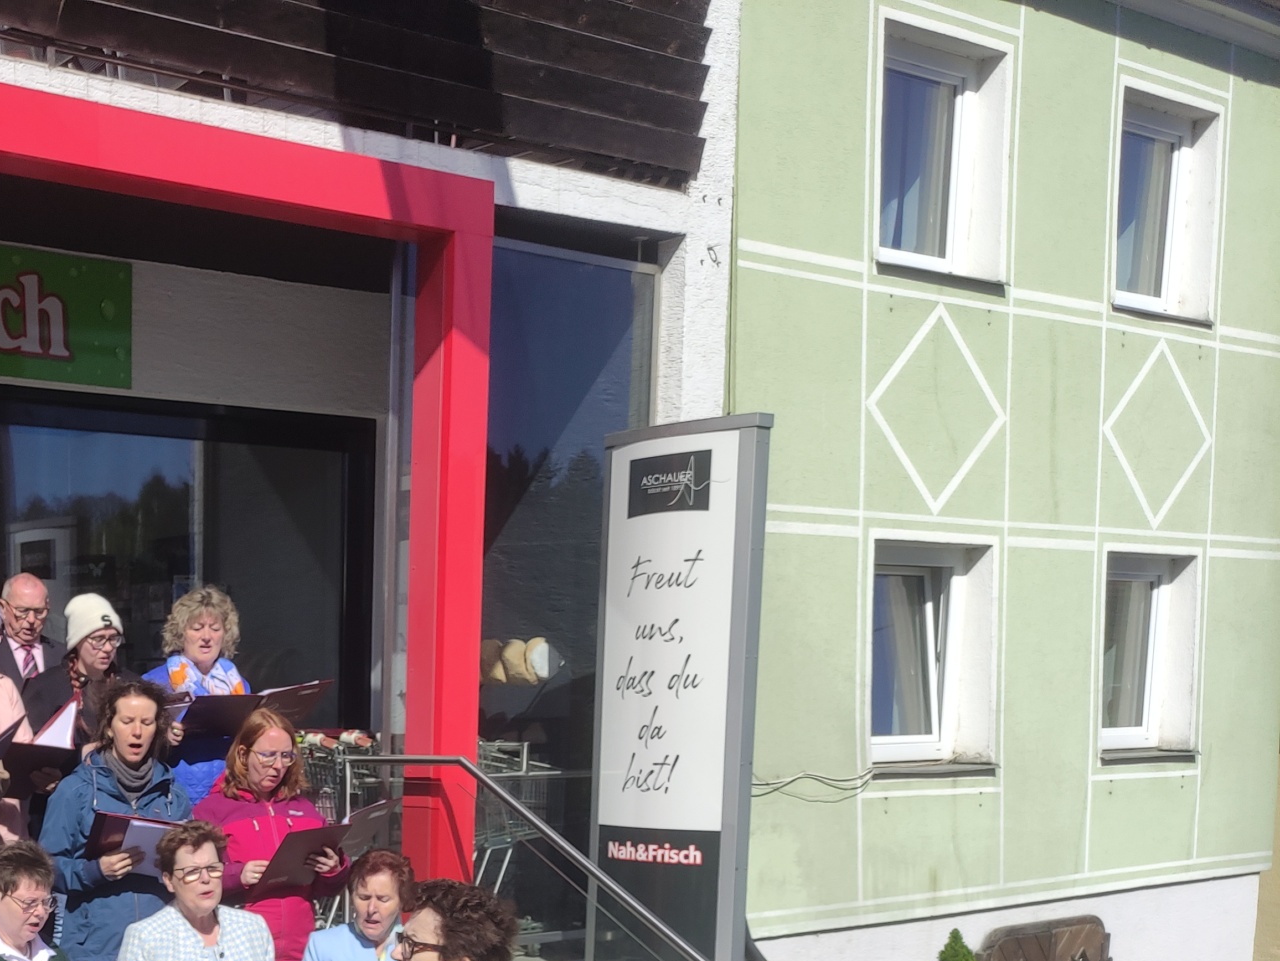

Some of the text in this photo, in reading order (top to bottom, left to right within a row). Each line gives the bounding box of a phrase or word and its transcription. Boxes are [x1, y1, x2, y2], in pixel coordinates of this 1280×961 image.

[640, 470, 693, 487] ASCHAUER
[627, 549, 704, 599] Freut
[634, 617, 684, 643] uns,
[616, 654, 704, 701] dass du
[637, 706, 667, 751] da
[622, 752, 680, 795] bist!
[607, 840, 703, 866] Nah&Frisch
